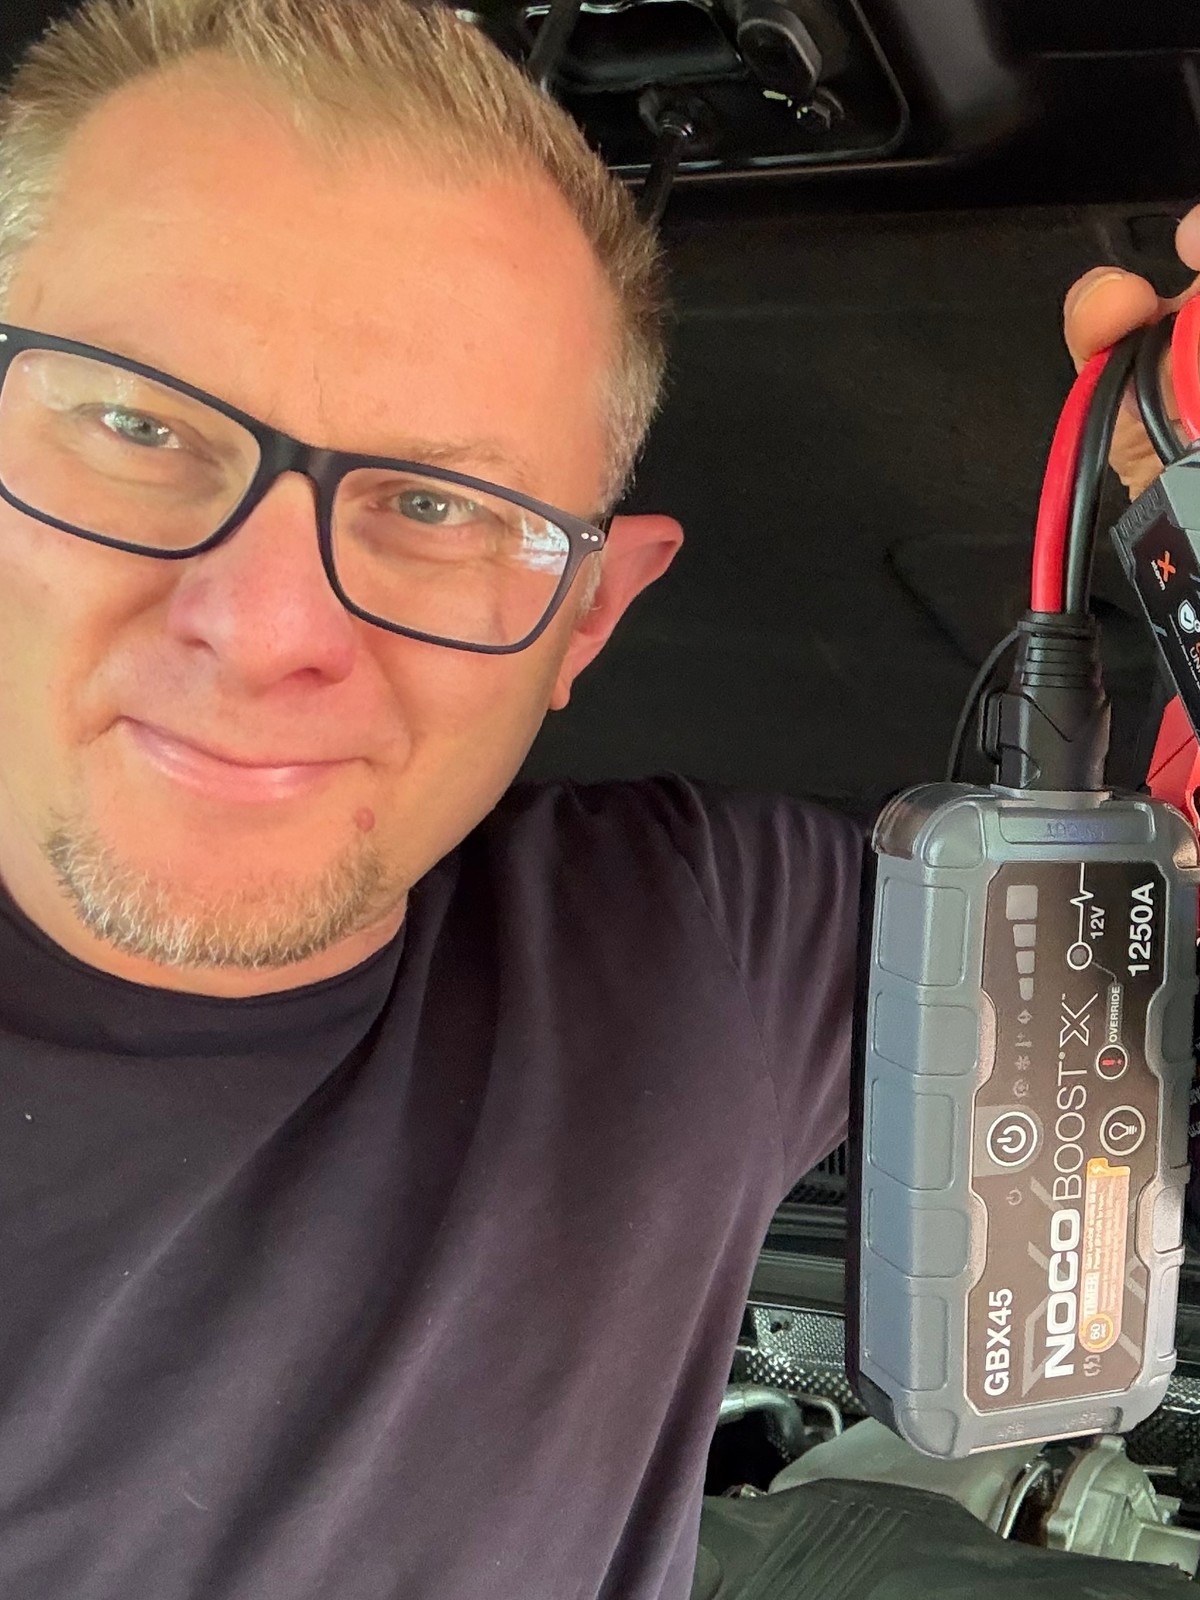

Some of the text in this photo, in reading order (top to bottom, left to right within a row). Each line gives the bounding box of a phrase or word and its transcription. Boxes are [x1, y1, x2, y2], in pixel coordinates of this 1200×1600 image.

[1090, 906, 1106, 939] 12V
[1128, 882, 1155, 977] 1250A
[1109, 985, 1121, 1043] OVERRIDE
[1052, 1060, 1088, 1201] BOOST
[1044, 1208, 1081, 1379] NOCO
[1090, 1322, 1101, 1341] 60
[984, 1288, 1013, 1396] GBX45
